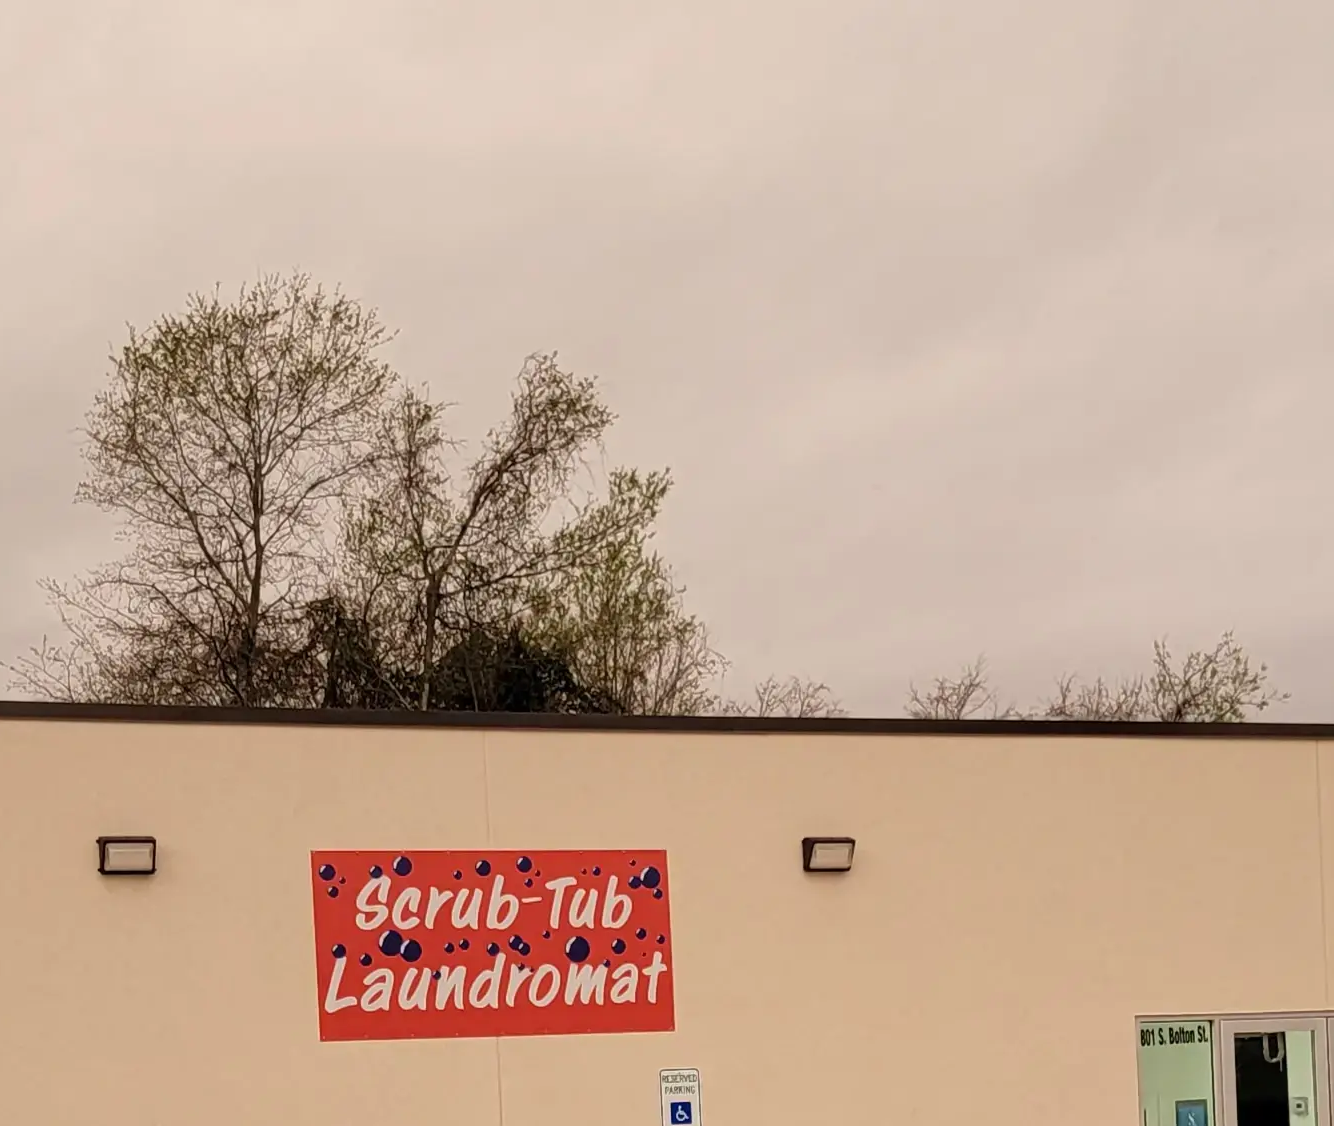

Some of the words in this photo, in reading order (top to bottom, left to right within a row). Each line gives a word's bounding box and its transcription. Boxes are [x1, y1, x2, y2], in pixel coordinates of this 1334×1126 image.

[355, 874, 633, 931] Scrub-Tub
[324, 951, 668, 1014] Laundromat
[1140, 1029, 1155, 1047] 801
[1158, 1027, 1167, 1045] S.
[1169, 1026, 1196, 1045] Bolton
[662, 1074, 697, 1084] RESERVED
[664, 1086, 696, 1095] PARKING
